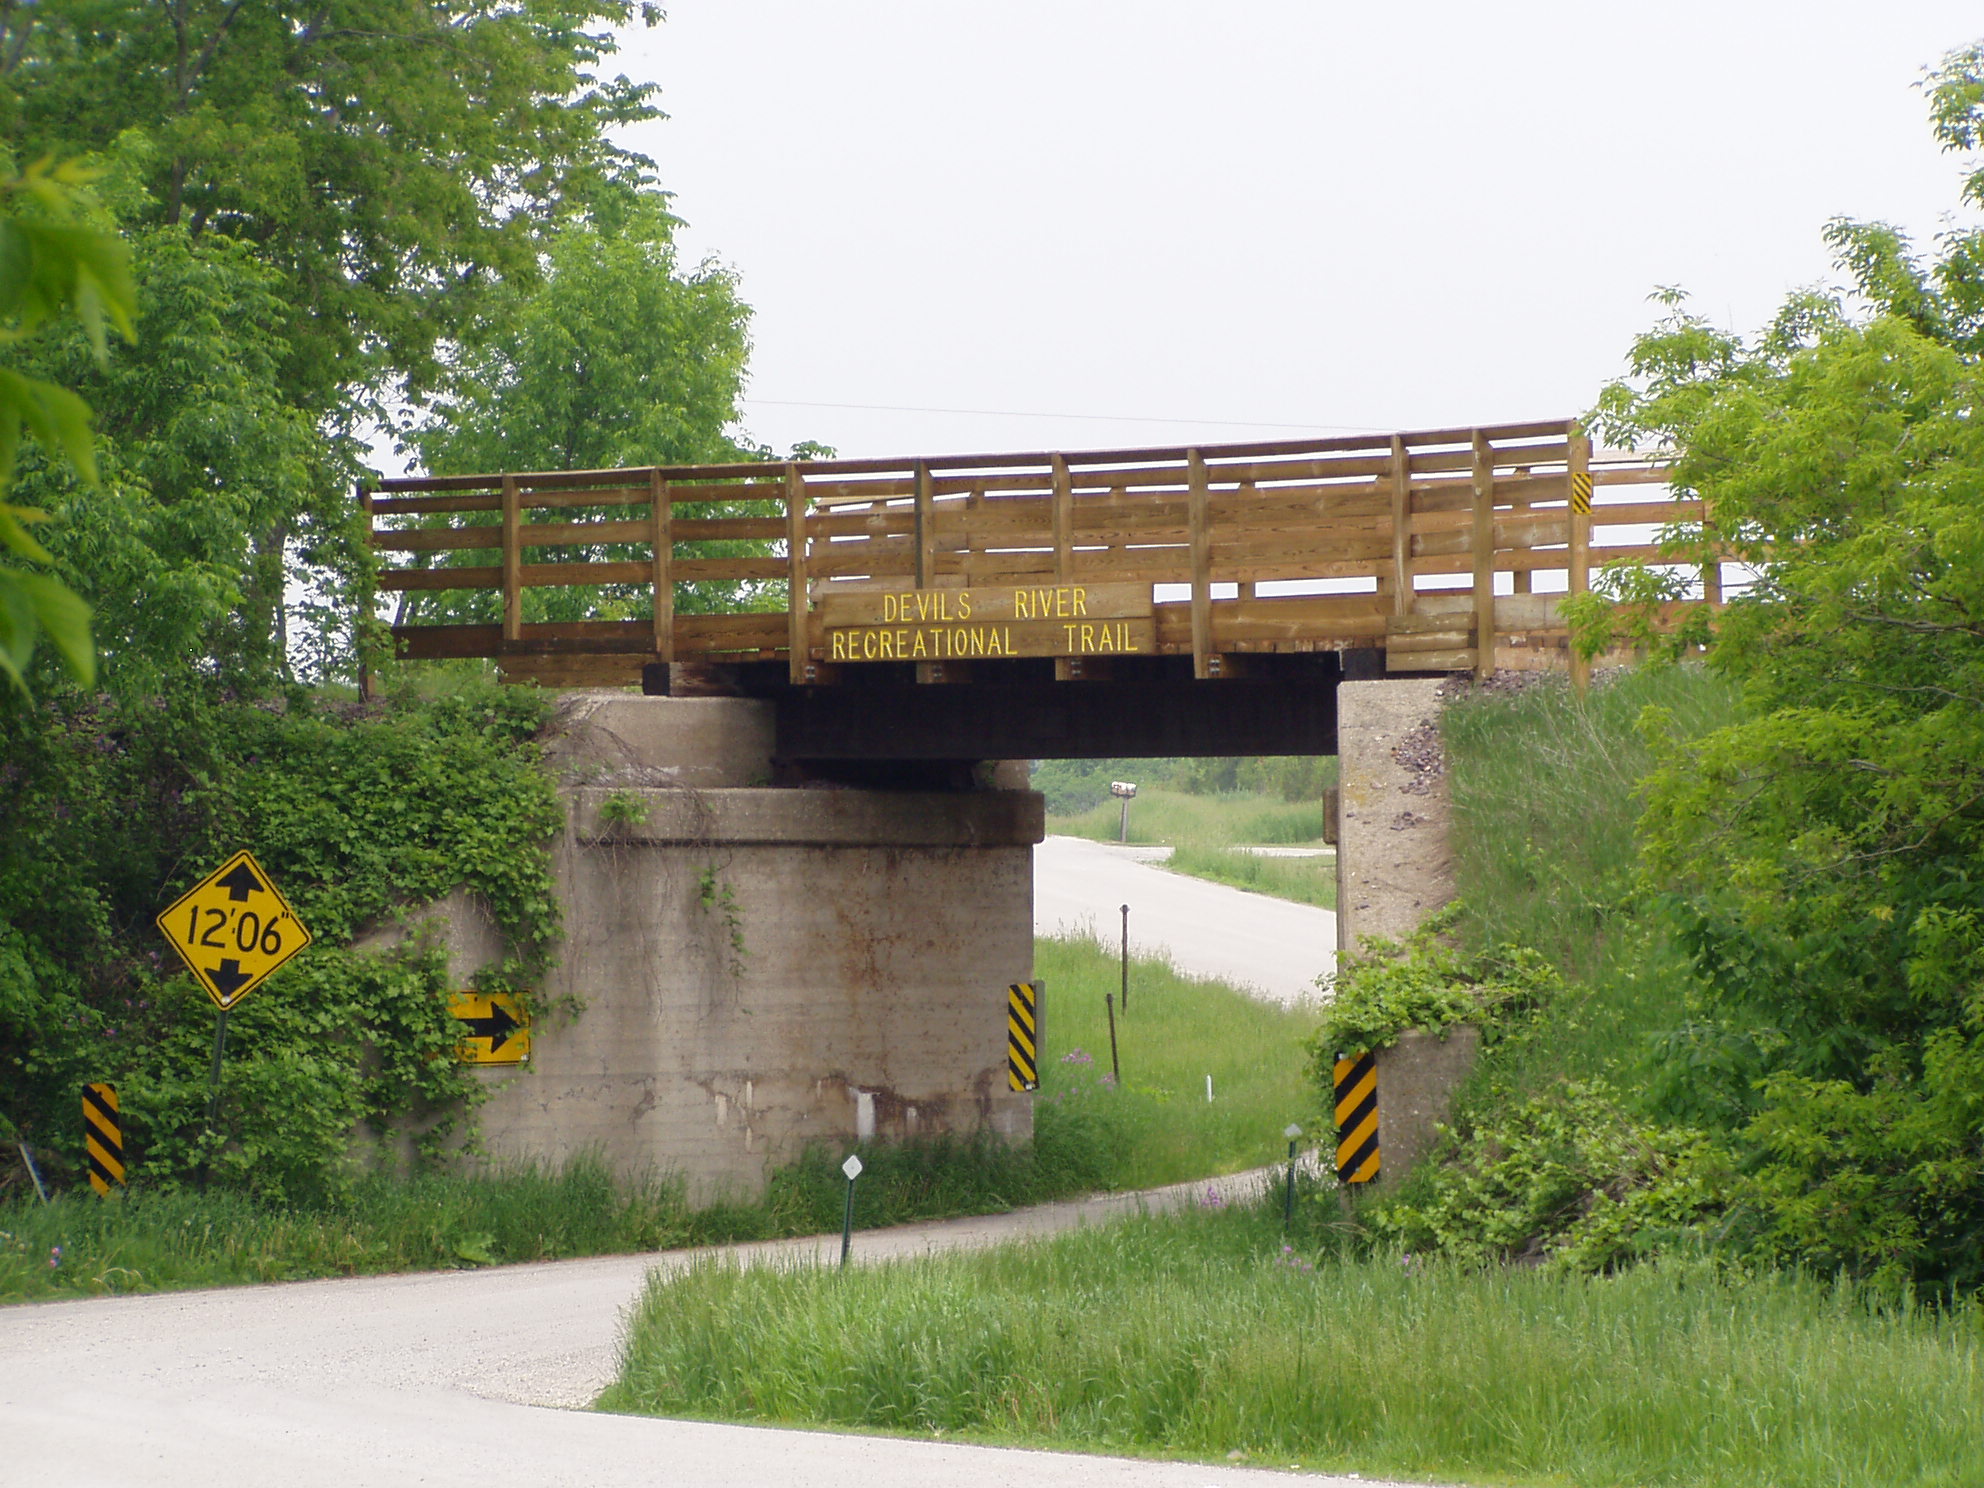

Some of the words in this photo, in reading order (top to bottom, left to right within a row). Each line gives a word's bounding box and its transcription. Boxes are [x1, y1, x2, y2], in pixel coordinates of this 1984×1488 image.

[884, 592, 972, 622] DEVILS
[1015, 587, 1087, 618] RIVER
[833, 627, 1018, 660] RECREATIONAL
[1063, 623, 1138, 652] TRAIL
